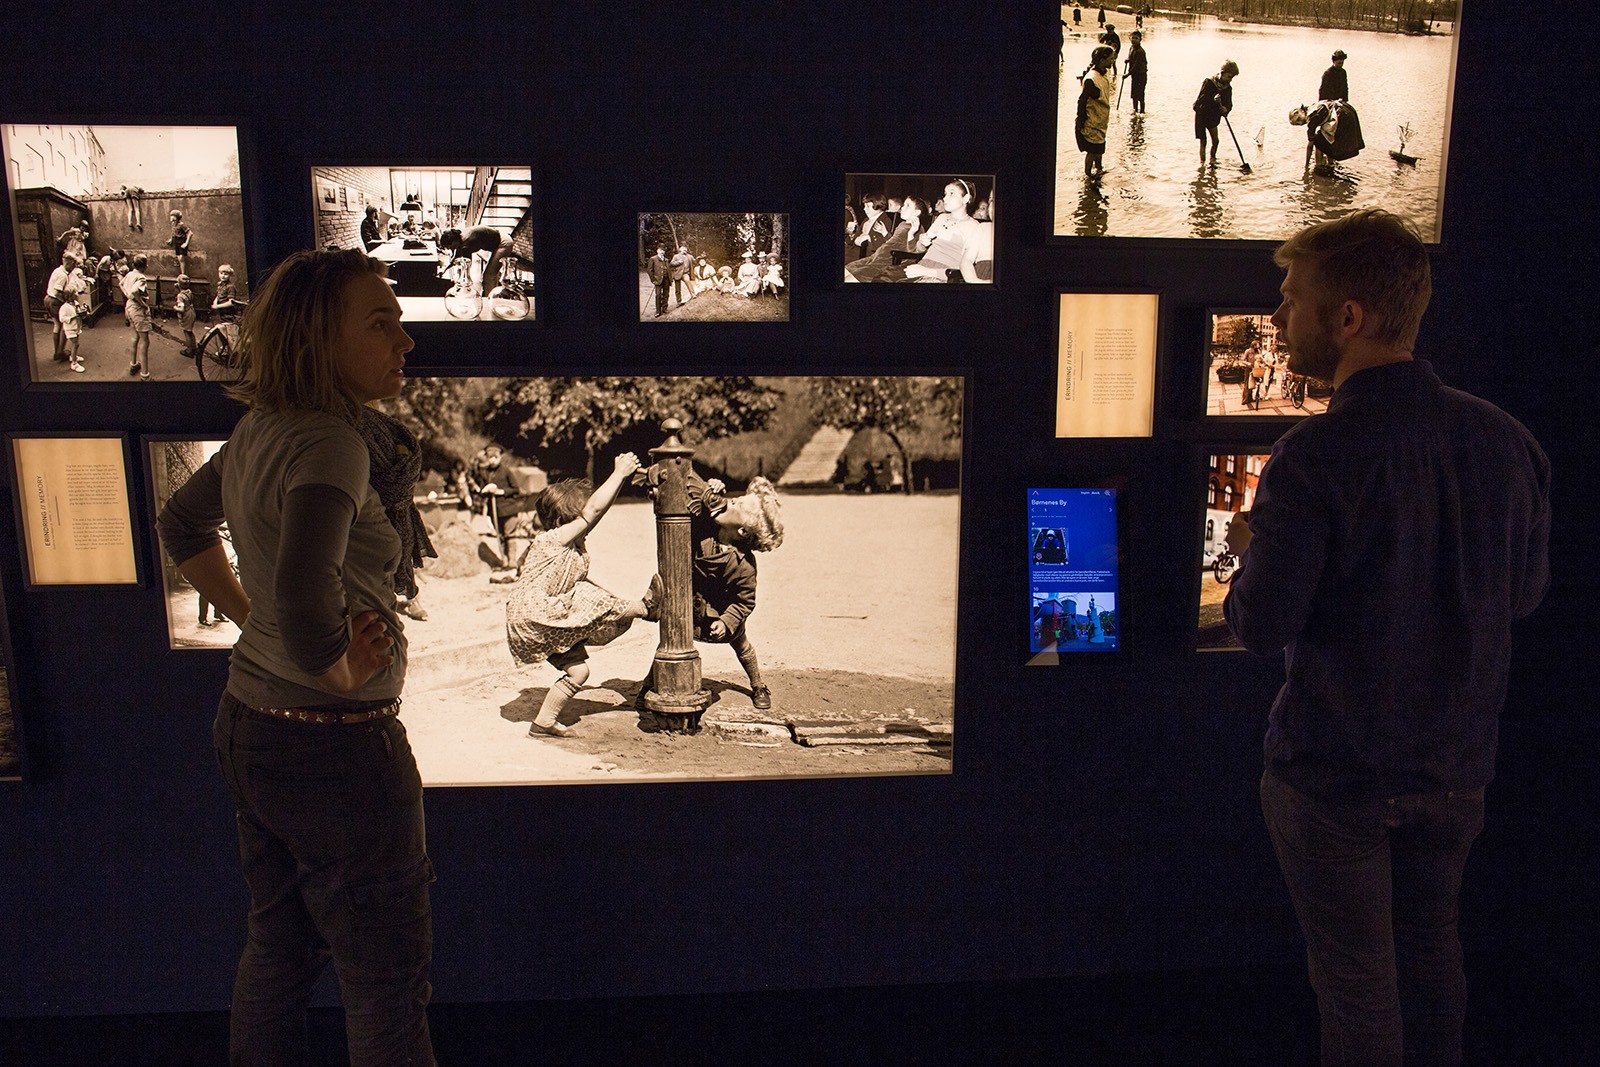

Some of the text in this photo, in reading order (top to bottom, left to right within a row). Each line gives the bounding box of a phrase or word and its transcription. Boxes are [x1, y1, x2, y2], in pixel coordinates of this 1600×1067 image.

[37, 475, 45, 503] MEMORY
[1059, 499, 1067, 507] By
[41, 510, 50, 546] ERINDRING
